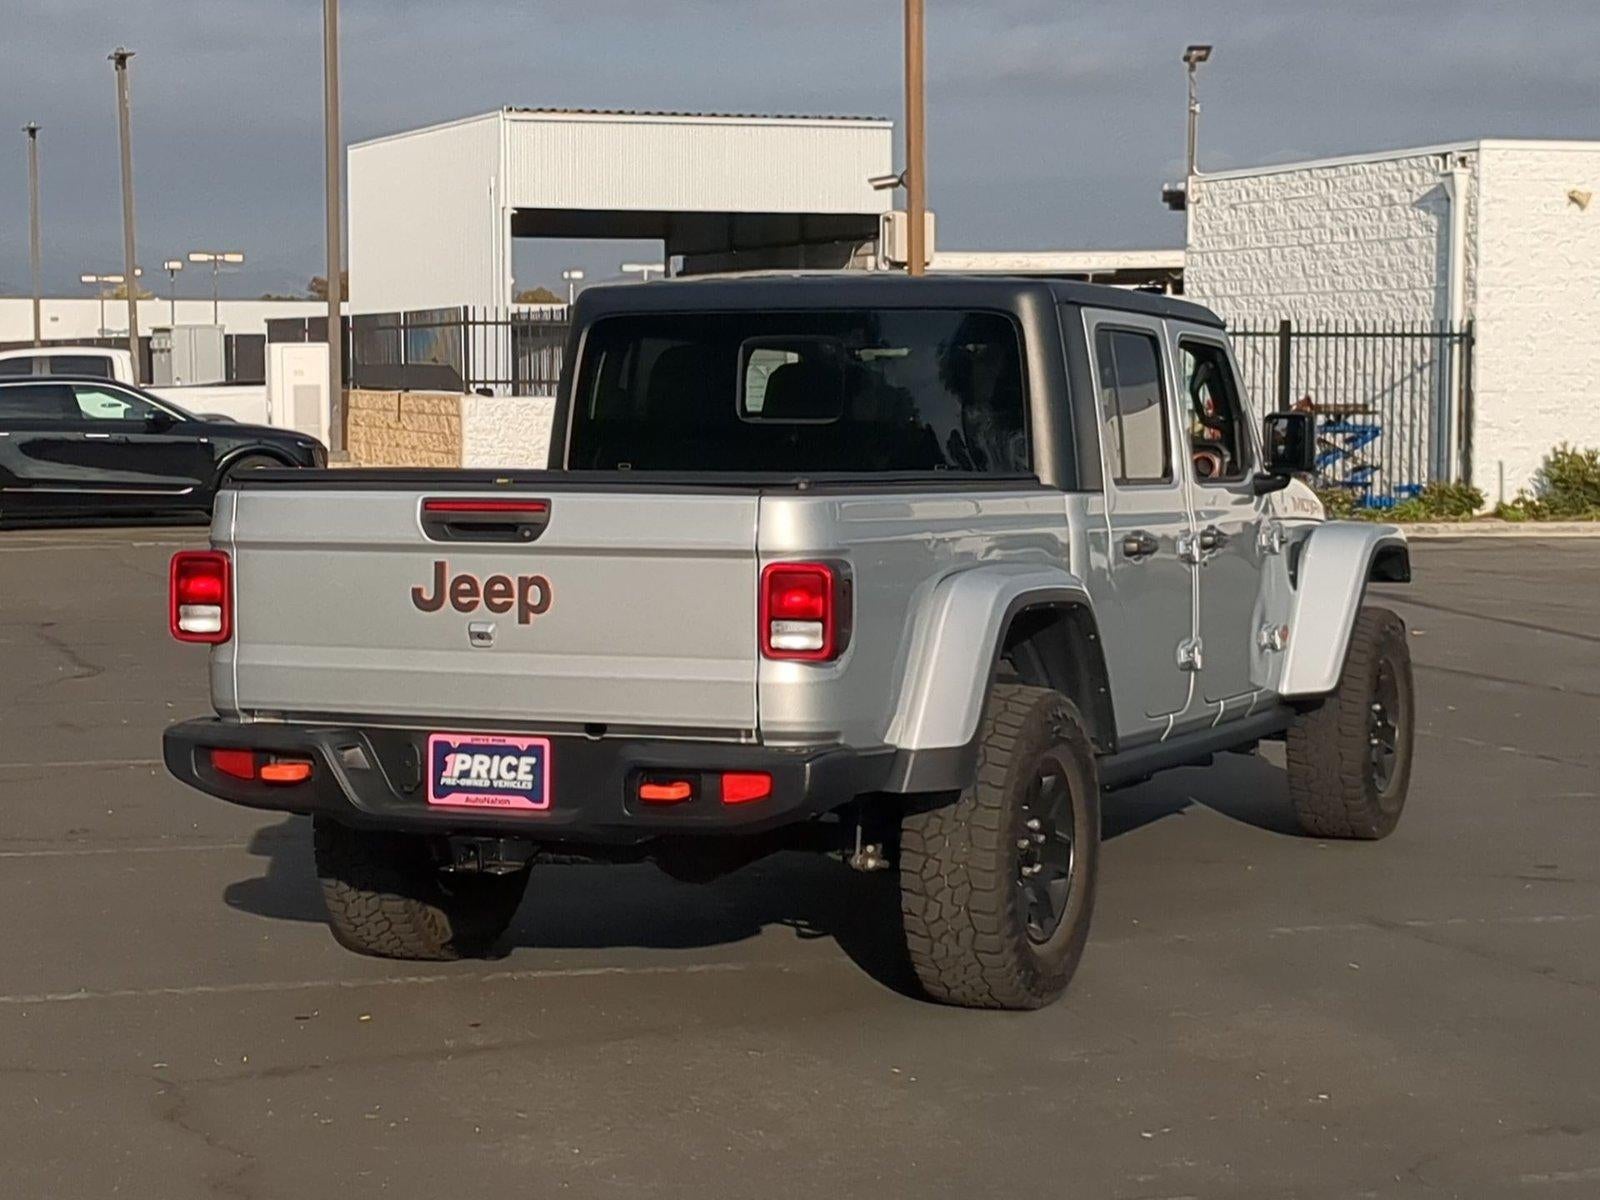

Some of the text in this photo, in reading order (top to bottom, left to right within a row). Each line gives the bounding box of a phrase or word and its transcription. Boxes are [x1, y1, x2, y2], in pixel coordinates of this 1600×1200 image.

[411, 561, 552, 625] Jeep
[441, 753, 537, 781] 1PRICE
[440, 777, 534, 791] PRE-OWNED VEHICLES
[464, 796, 511, 805] AutoNation
